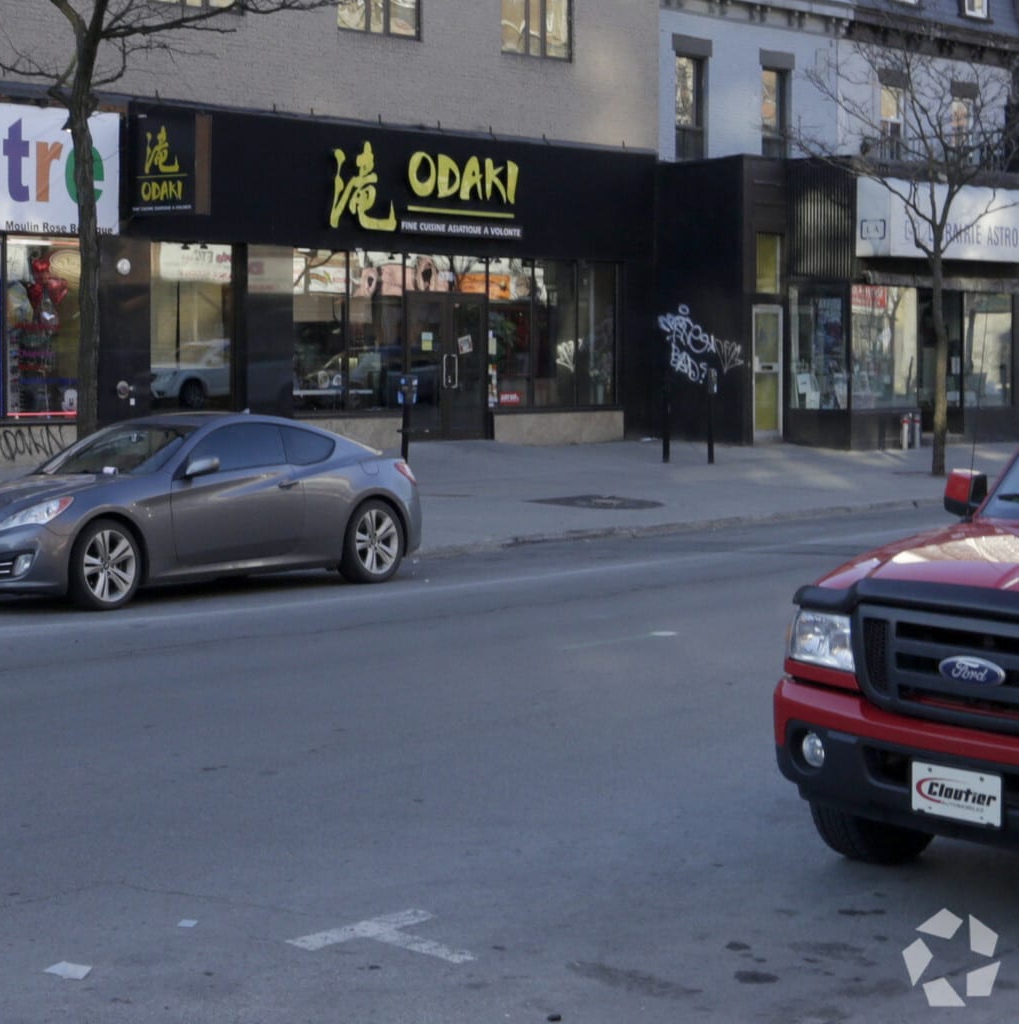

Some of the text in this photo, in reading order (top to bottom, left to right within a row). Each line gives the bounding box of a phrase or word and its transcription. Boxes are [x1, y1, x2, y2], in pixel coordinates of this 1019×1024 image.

[408, 151, 519, 204] ODAKI
[141, 180, 183, 202] ODAKI
[5, 220, 40, 232] Moulin
[42, 222, 67, 234] Rose
[401, 220, 418, 231] FINE
[419, 222, 446, 233] CUISINE
[447, 224, 482, 235] ASIATIQUE
[928, 222, 981, 245] LRAIRIE
[986, 224, 1019, 248] ASTRO
[950, 660, 988, 682] Ford
[927, 781, 996, 807] Cloutier
